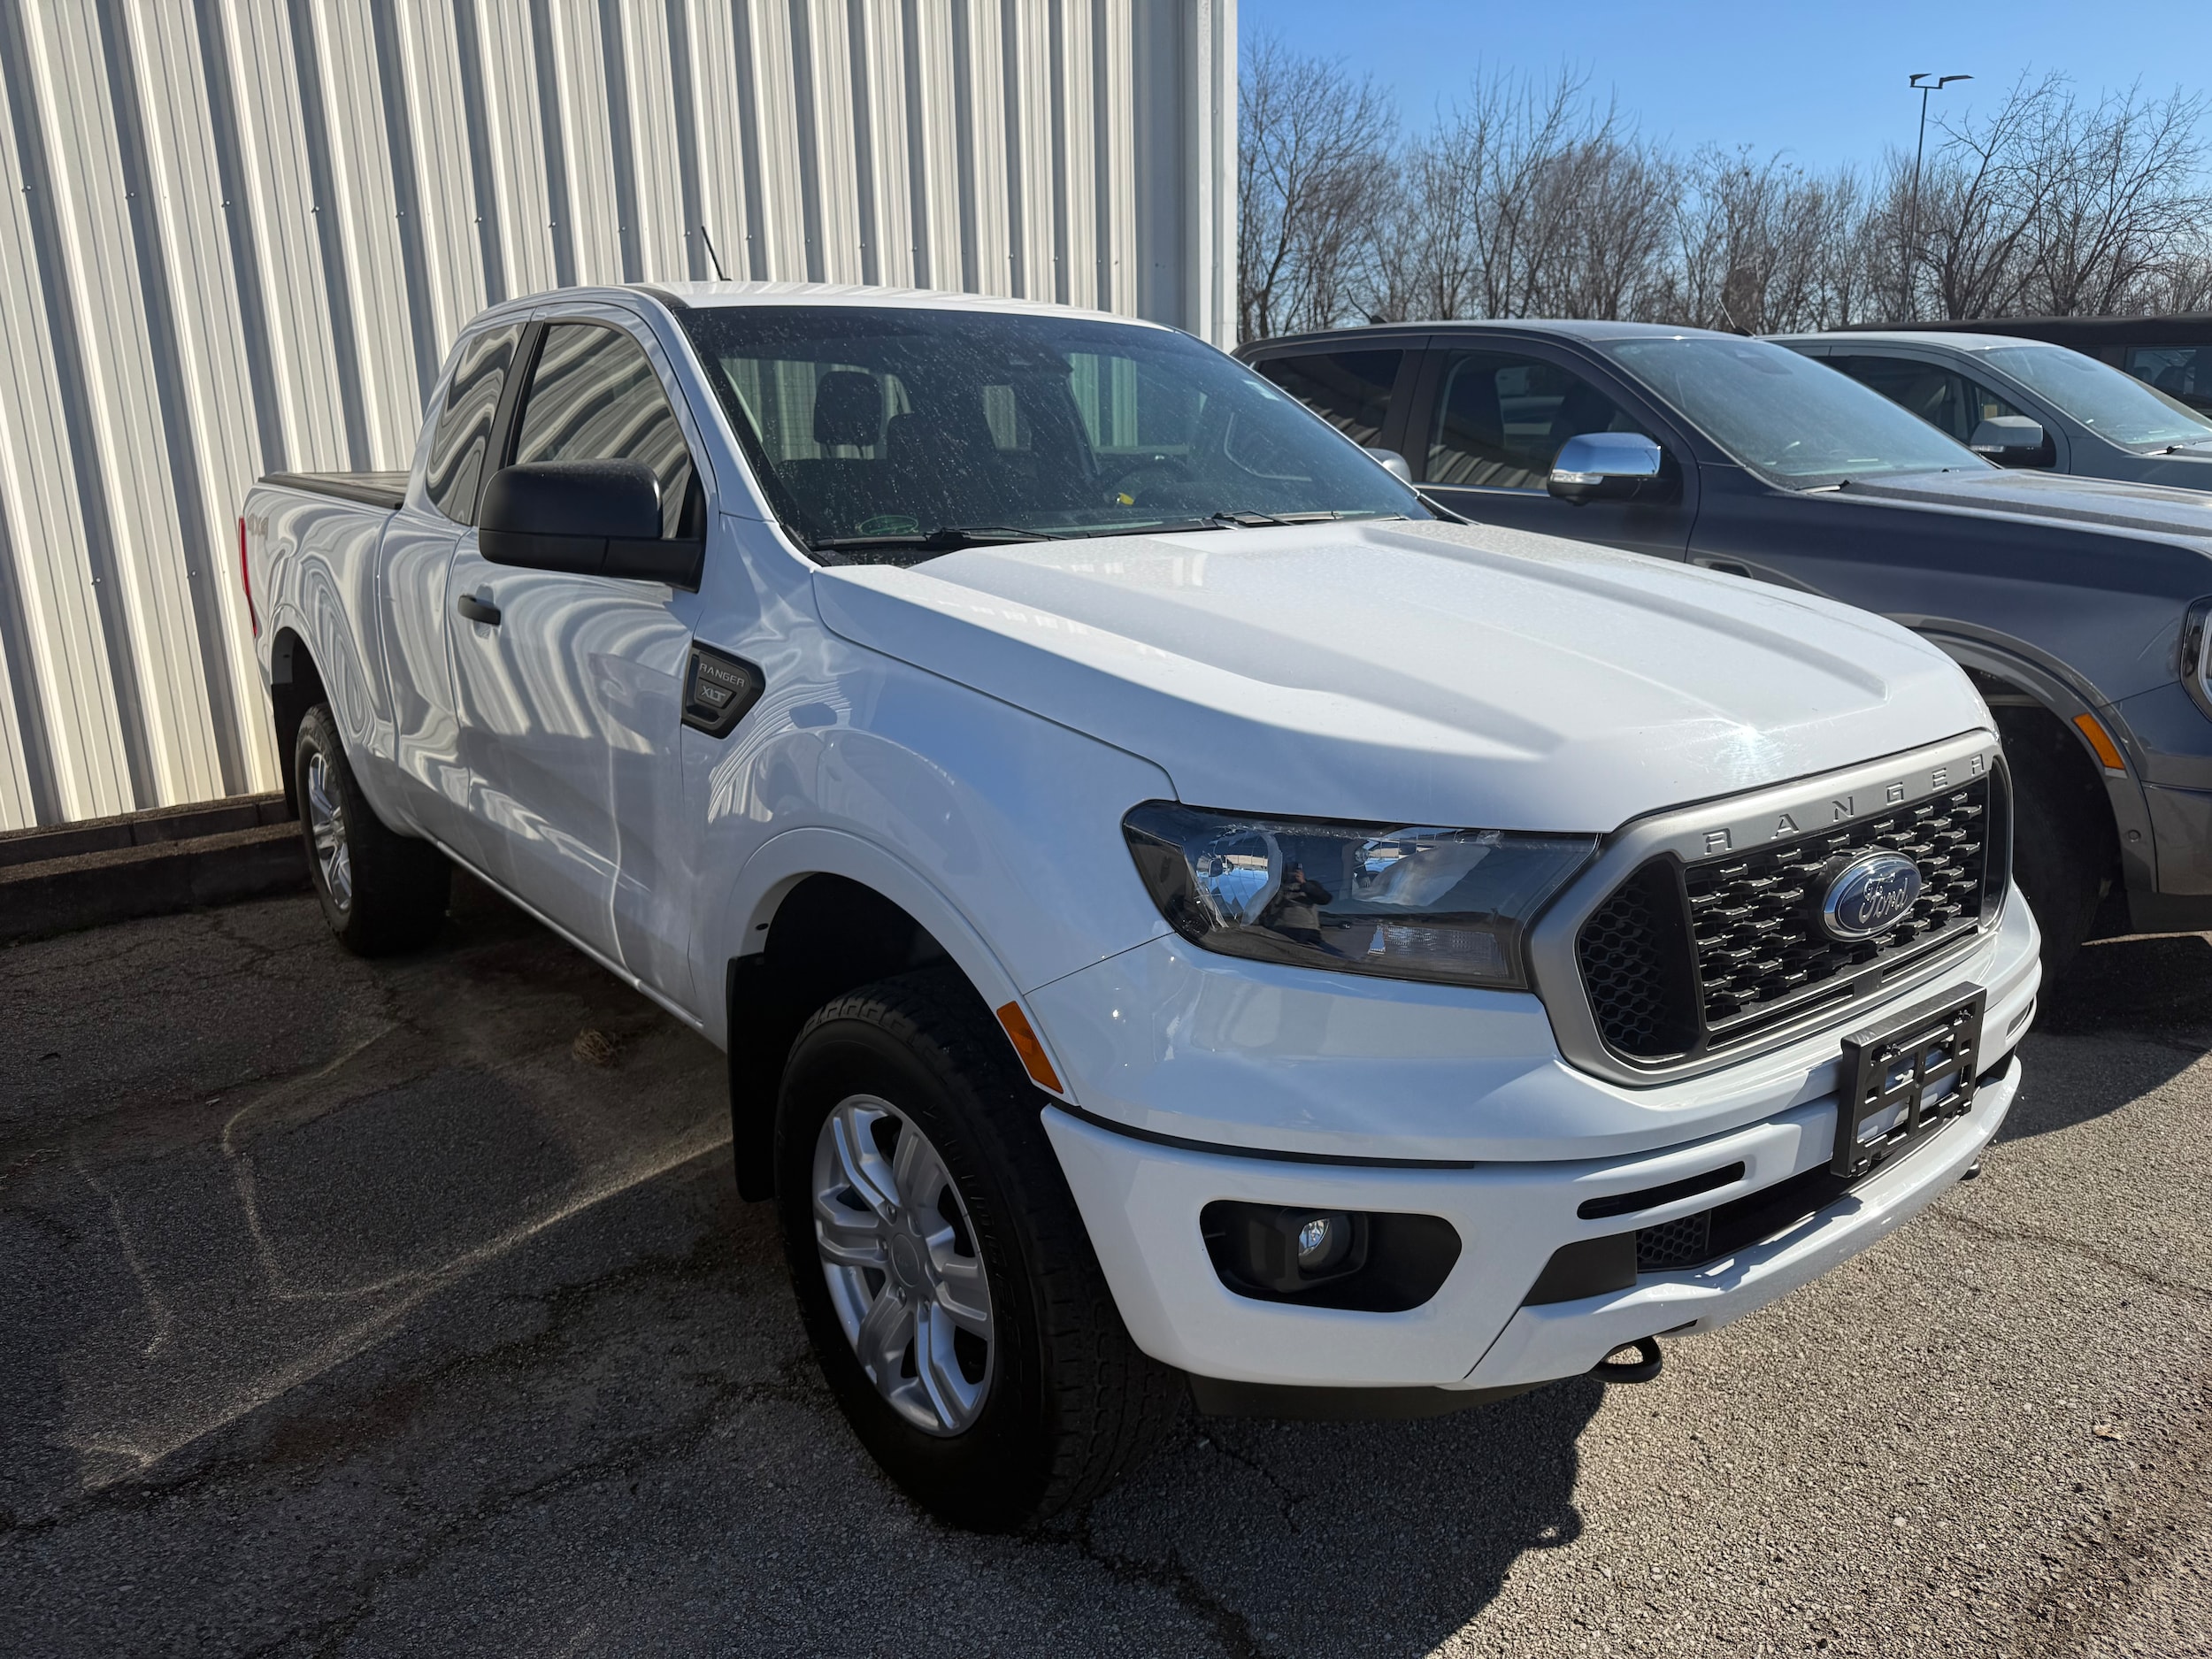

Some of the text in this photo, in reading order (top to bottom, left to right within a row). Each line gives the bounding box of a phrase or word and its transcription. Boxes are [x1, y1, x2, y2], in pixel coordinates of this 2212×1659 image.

[700, 663, 745, 687] RANGER
[701, 685, 726, 703] XLT
[1702, 754, 1985, 856] RANGER
[1858, 872, 1909, 924] Ford
